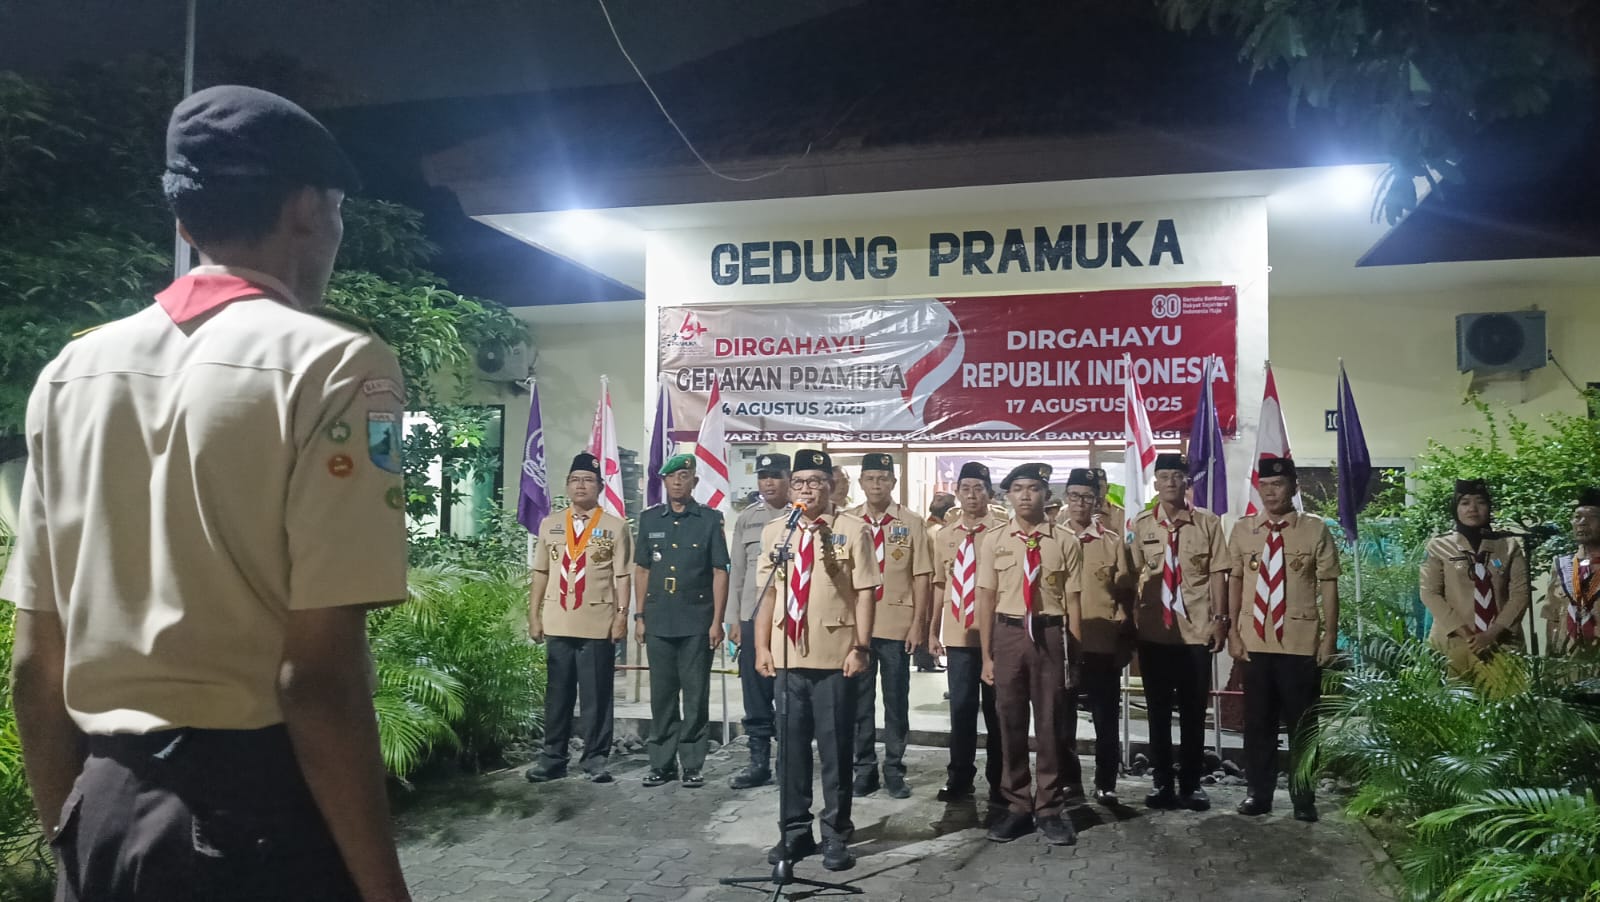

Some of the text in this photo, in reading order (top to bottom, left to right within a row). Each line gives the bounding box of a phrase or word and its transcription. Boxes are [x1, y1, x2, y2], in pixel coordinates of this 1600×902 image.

[711, 219, 1184, 285] GEDUNG PRAMUKA
[1152, 294, 1181, 318] 80
[715, 336, 867, 356] DIRGAHAYU
[1008, 325, 1182, 350] DIRGAHAYU
[789, 364, 906, 390] PRAMUKA
[962, 360, 1081, 388] REPUBLIK
[735, 402, 819, 415] AGUSTUS
[824, 401, 866, 415] 2025
[1006, 396, 1182, 414] 17 AGUSTUS 025
[947, 432, 1040, 441] PRAMUKA
[1045, 430, 1181, 440] BANYUWNGI
